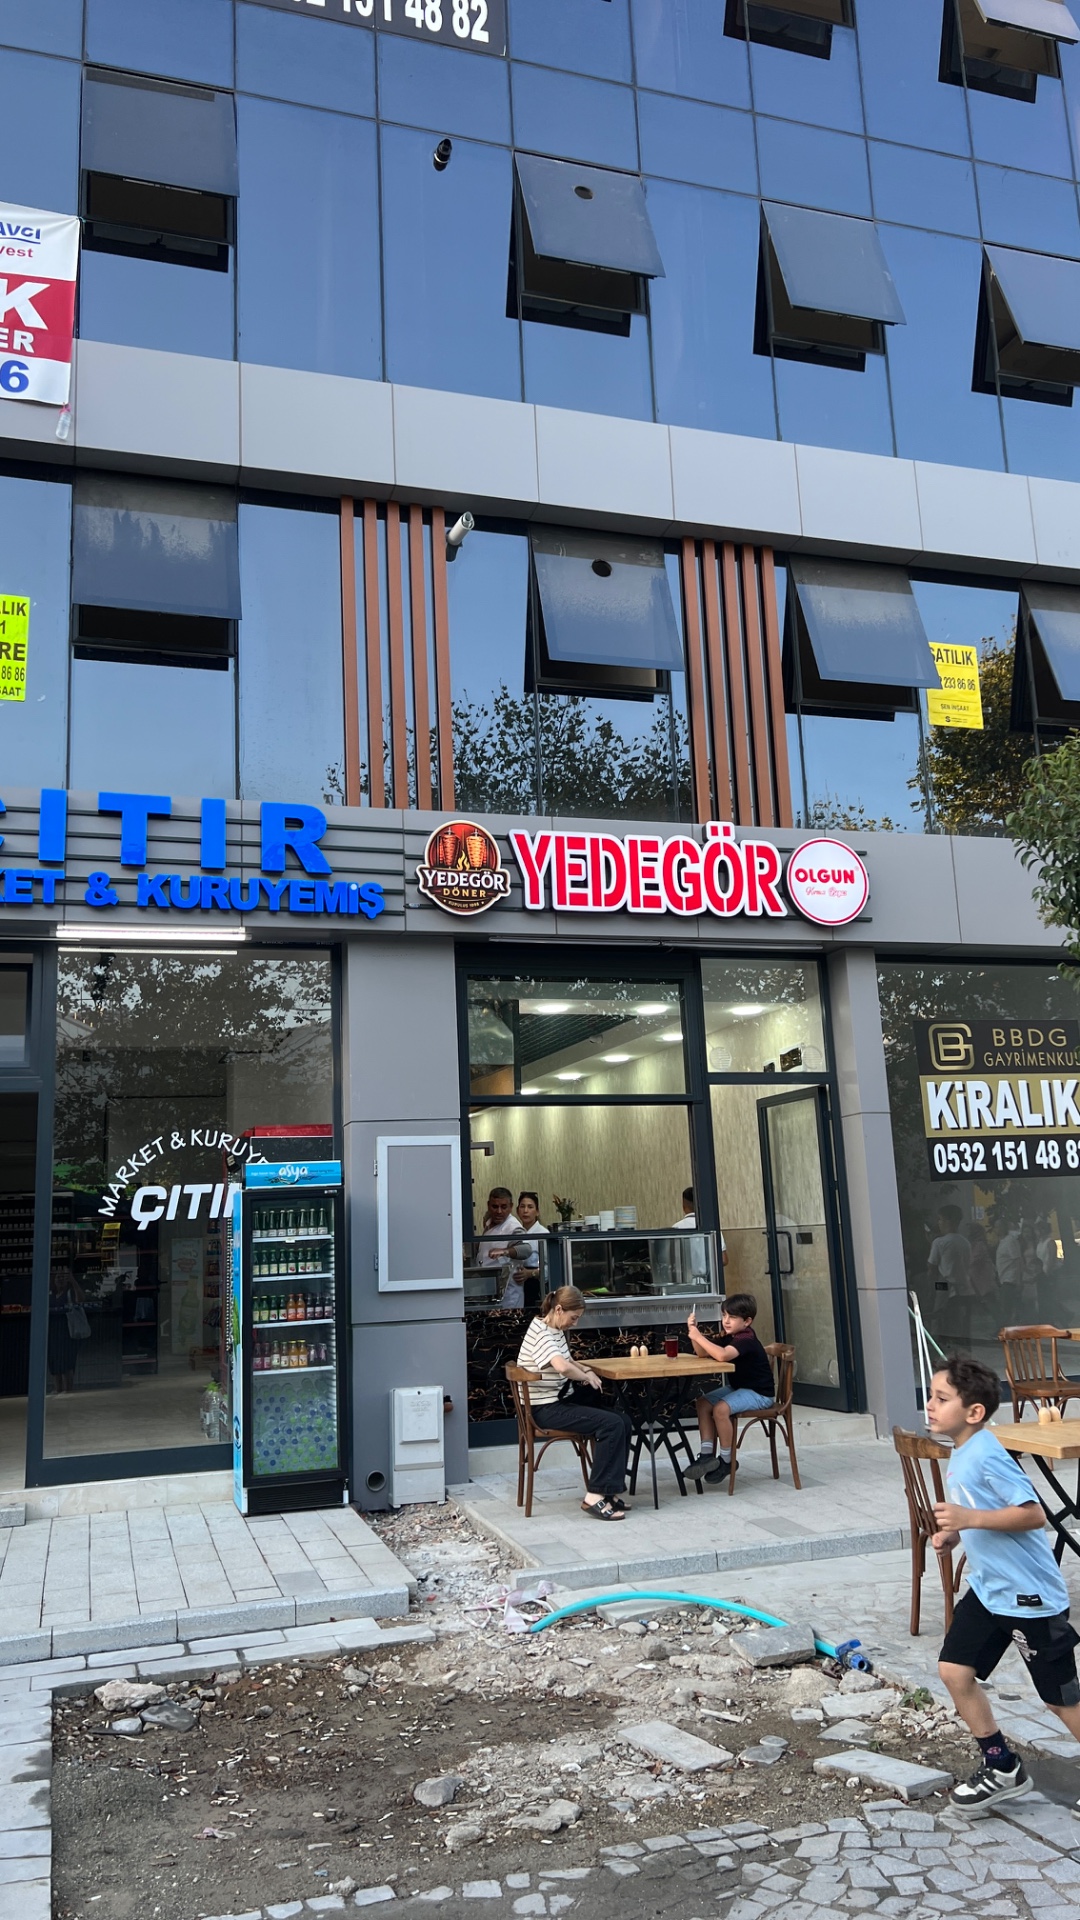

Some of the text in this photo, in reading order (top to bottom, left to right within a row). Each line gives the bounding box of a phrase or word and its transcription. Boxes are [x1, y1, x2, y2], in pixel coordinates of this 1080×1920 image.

[405, 0, 443, 32] 48
[452, 0, 489, 43] 82
[0, 360, 29, 393] 6
[0, 601, 27, 616] LIK
[1, 665, 25, 682] 86 86
[943, 676, 956, 689] 233
[957, 678, 966, 690] 86
[967, 679, 976, 691] 86
[0, 788, 332, 875] ITIR
[422, 868, 506, 892] YEDEGÖR
[512, 822, 785, 915] YEDEGÖR
[795, 867, 855, 885] OLGUN
[0, 868, 65, 905] ET
[85, 872, 119, 907] &
[443, 887, 487, 898] DÖNER
[992, 1028, 1067, 1047] BBDG
[933, 1139, 1080, 1174] 0532 151 48 8
[98, 1129, 269, 1217] MARKET & KURUY
[278, 1164, 309, 1182] asya
